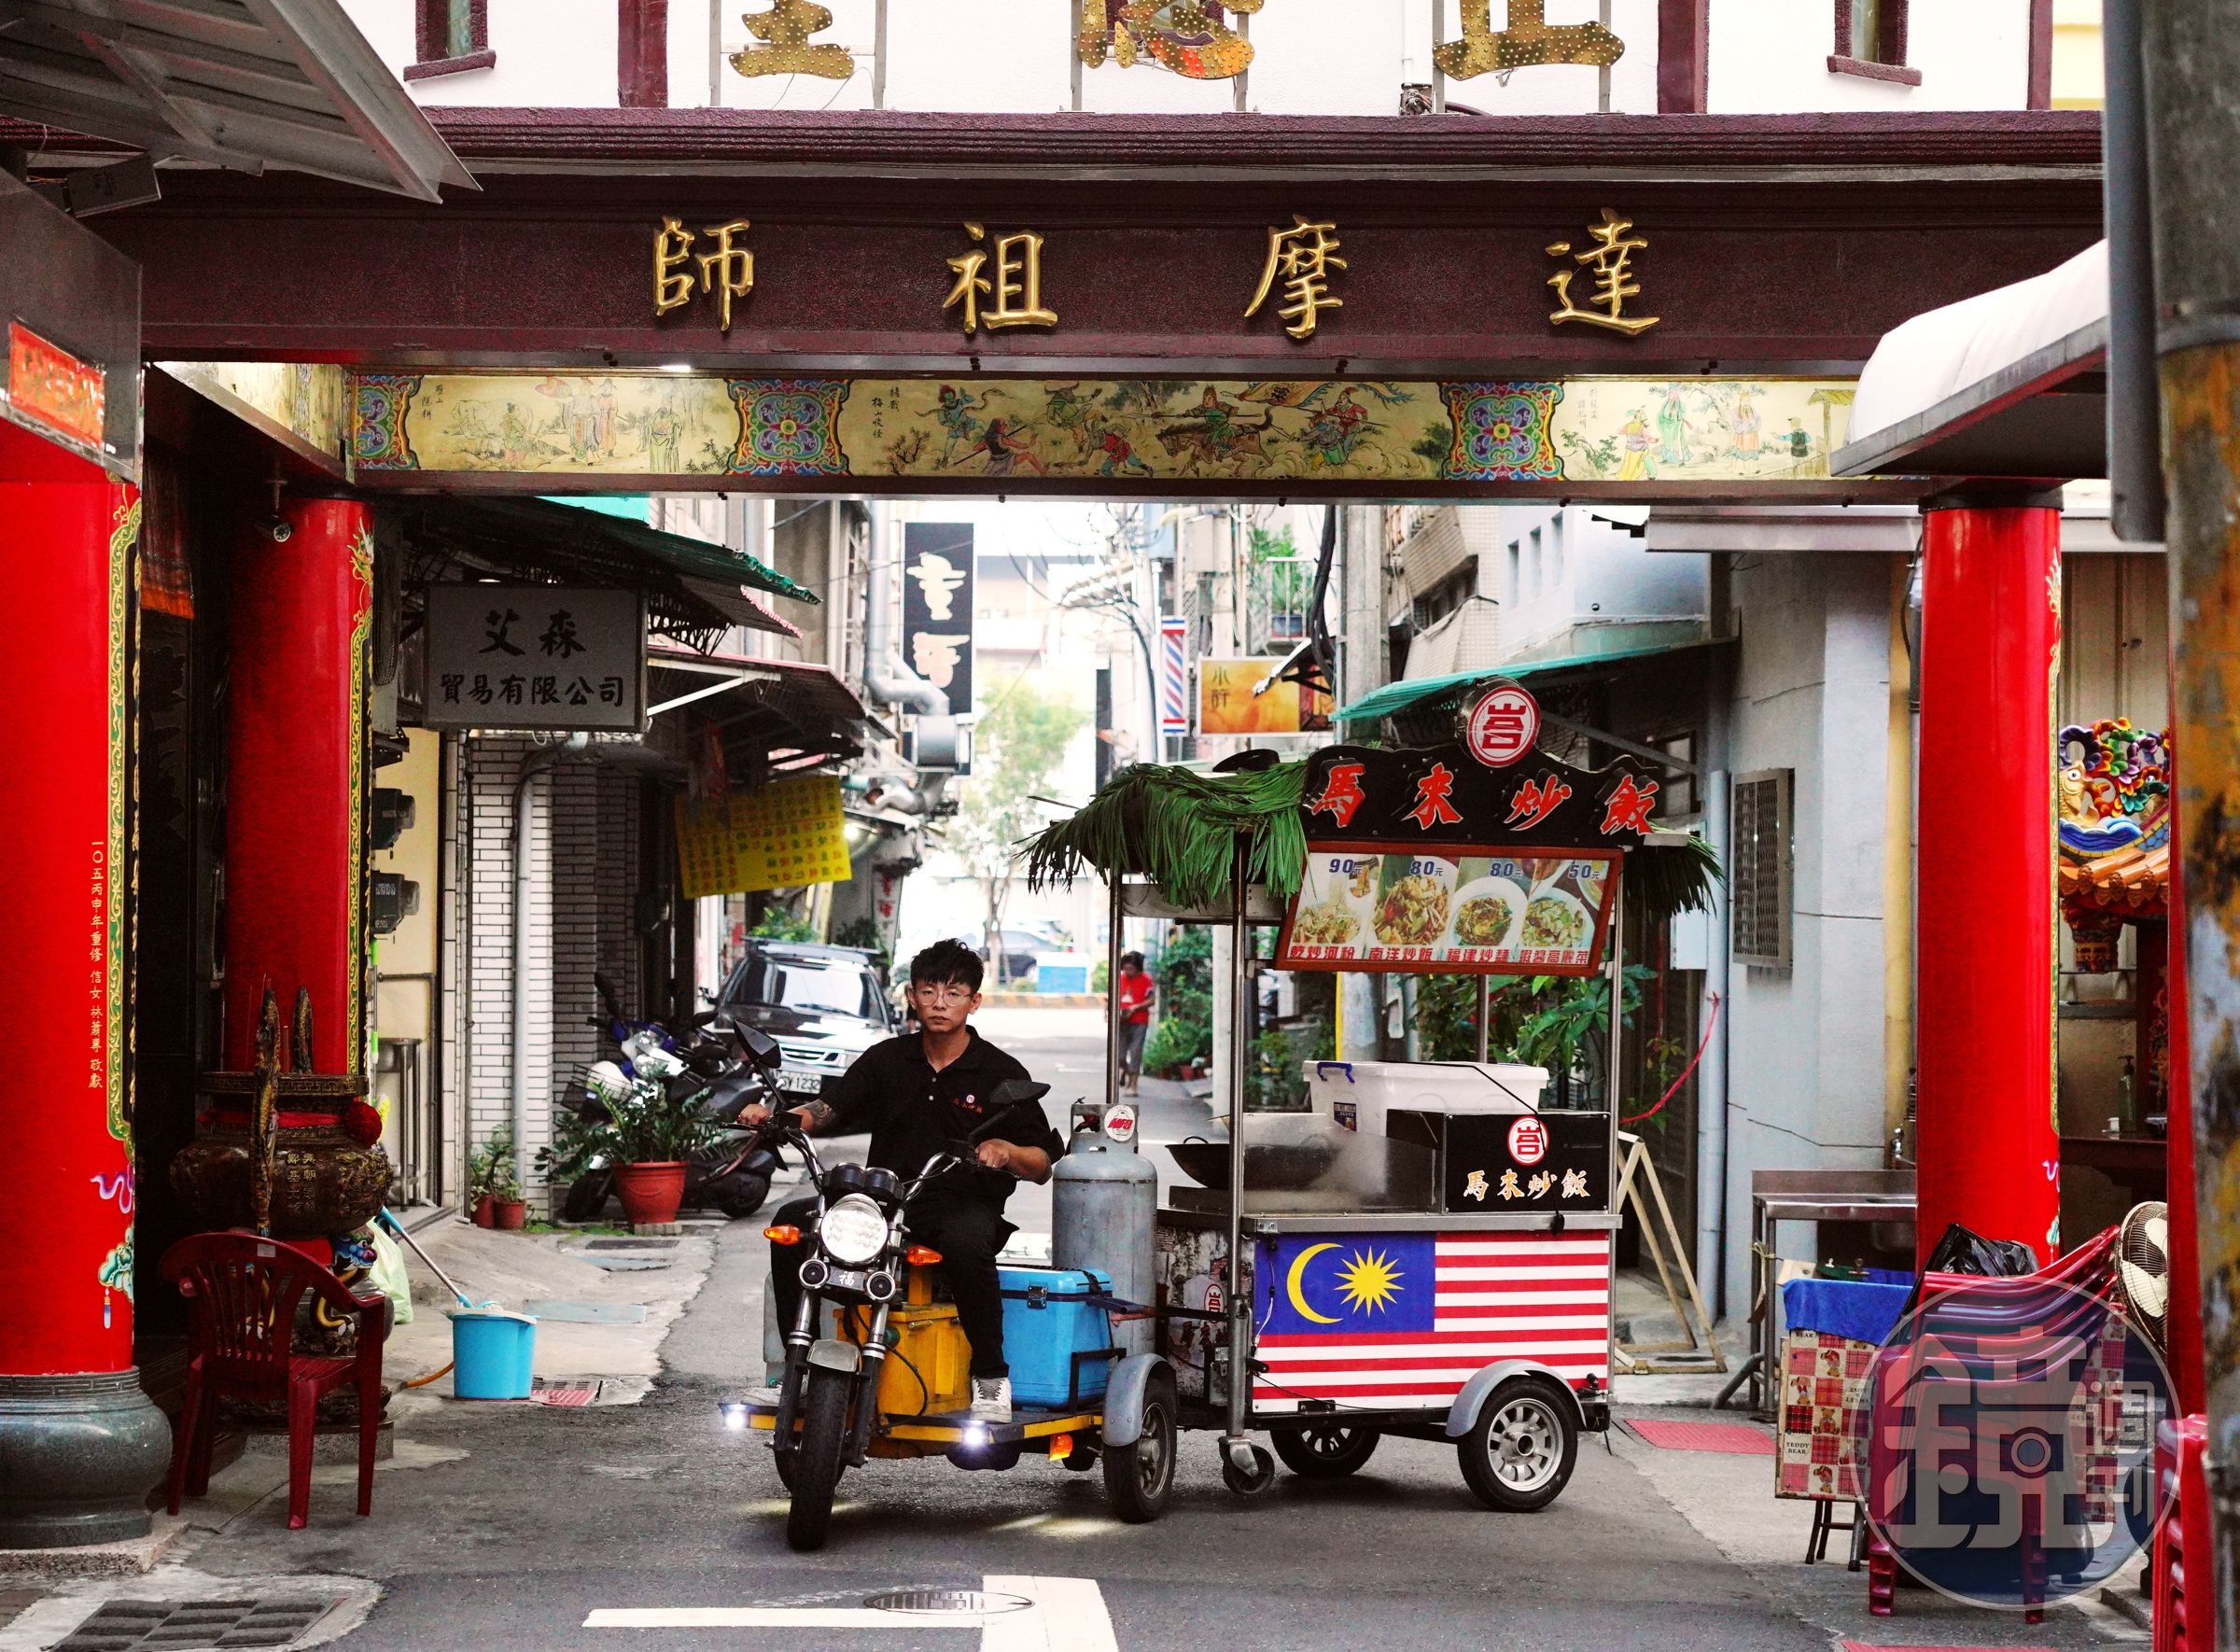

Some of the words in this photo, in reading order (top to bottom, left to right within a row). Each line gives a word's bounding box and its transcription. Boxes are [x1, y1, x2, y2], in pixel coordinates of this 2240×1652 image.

[478, 608, 587, 659] 艾森
[440, 674, 624, 707] 貿易有限公司
[1310, 762, 1660, 836] 馬來炒飯
[1329, 859, 1363, 875] 90元
[1410, 861, 1444, 876] 80元
[1490, 862, 1523, 878] 80元
[1569, 864, 1601, 880] 50元
[1369, 946, 1434, 961] 南洋炒飯
[1463, 1168, 1591, 1202] 馬來炒飯
[838, 1270, 855, 1287] 福
